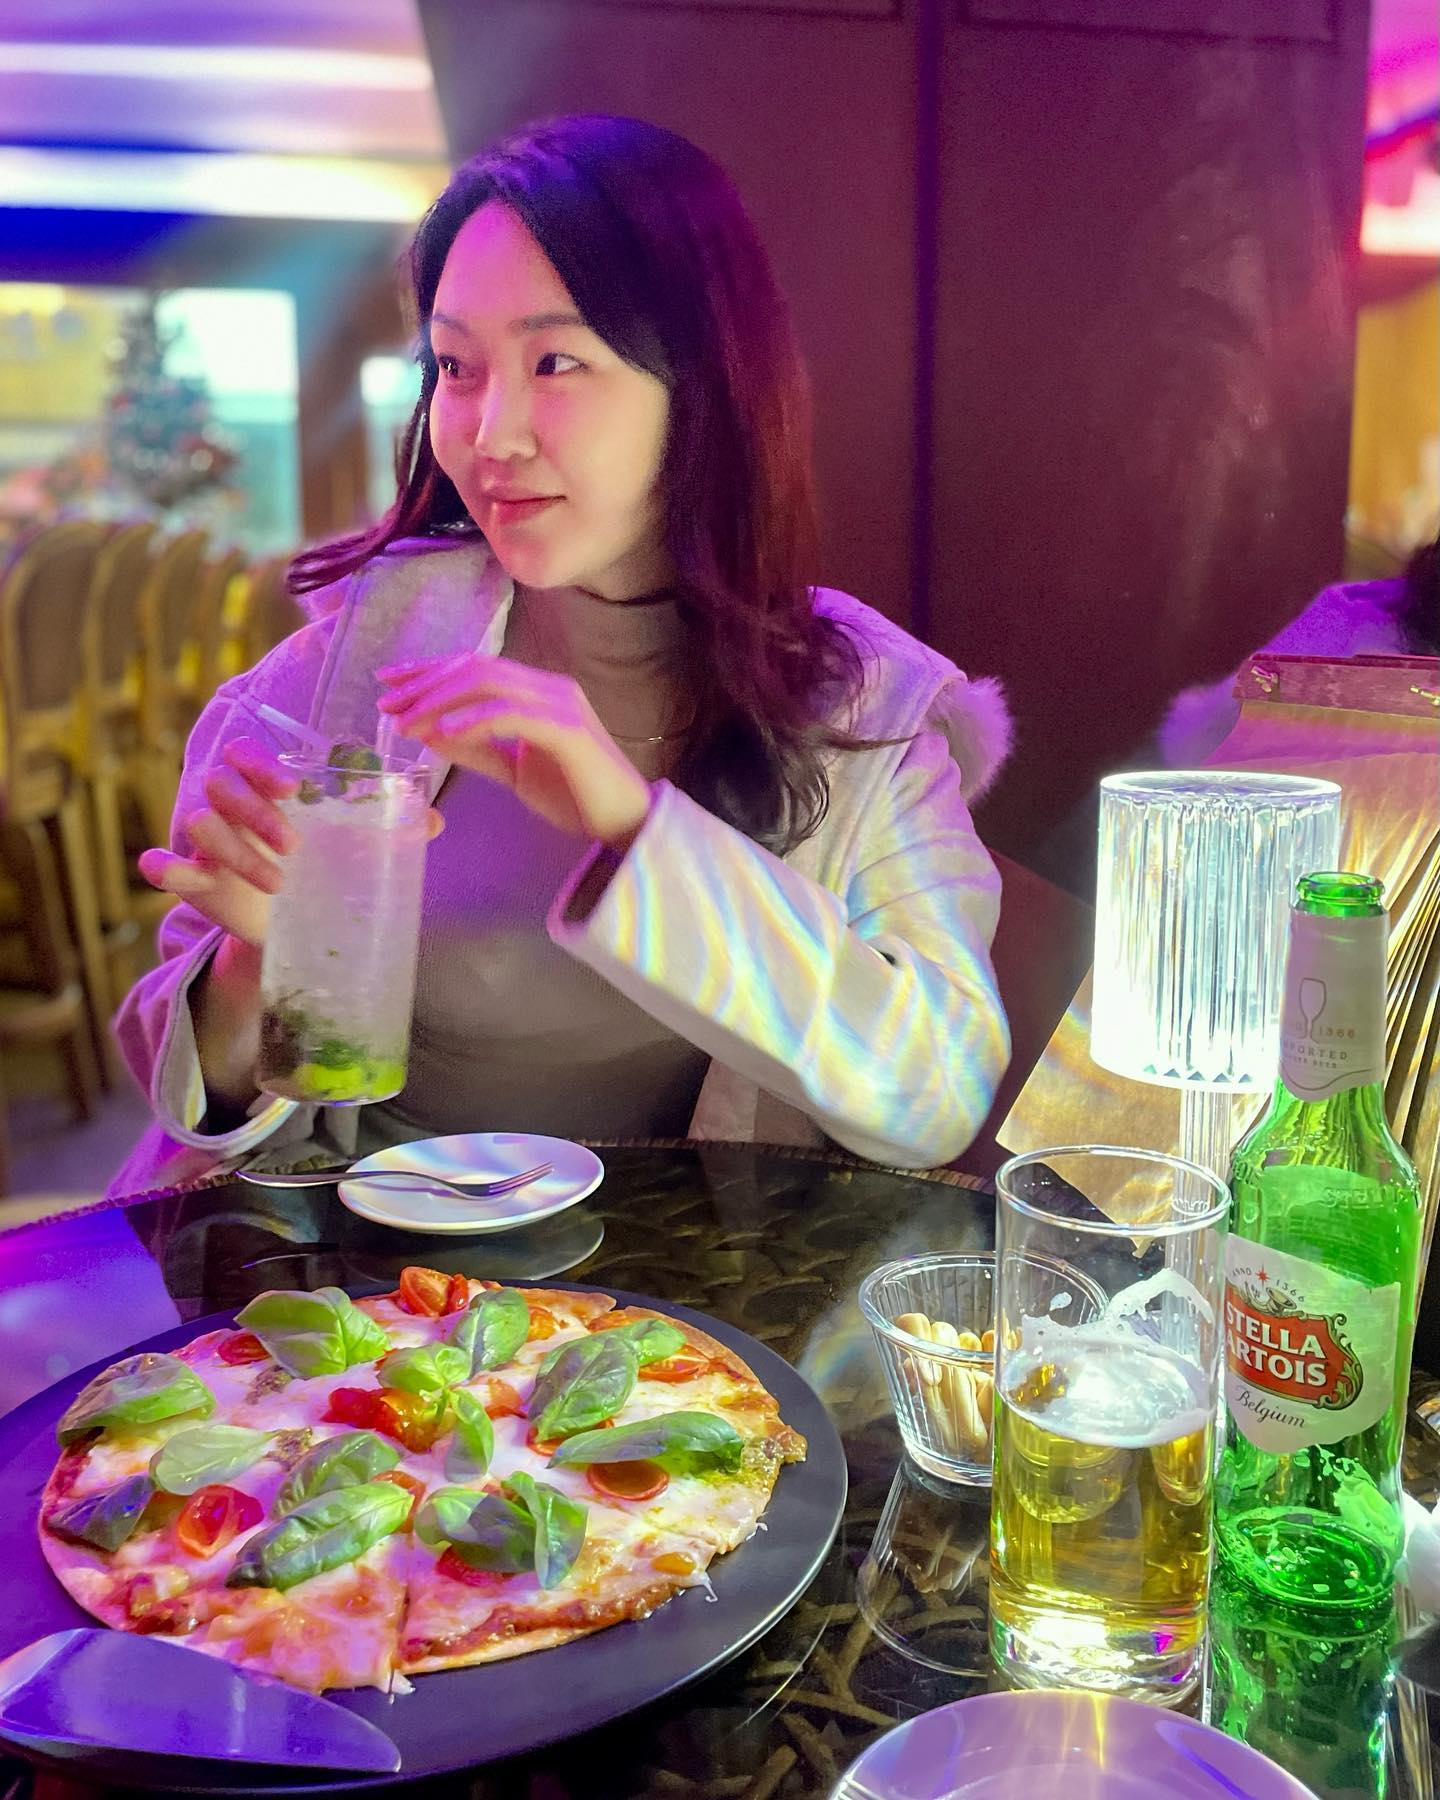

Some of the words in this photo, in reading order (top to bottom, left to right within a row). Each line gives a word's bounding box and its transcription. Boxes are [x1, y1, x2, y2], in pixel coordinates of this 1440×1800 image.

[1276, 1279, 1305, 1302] 1366
[1226, 1301, 1327, 1359] STELLA
[1226, 1327, 1328, 1388] ARTOIS
[1235, 1385, 1306, 1429] Belgium
